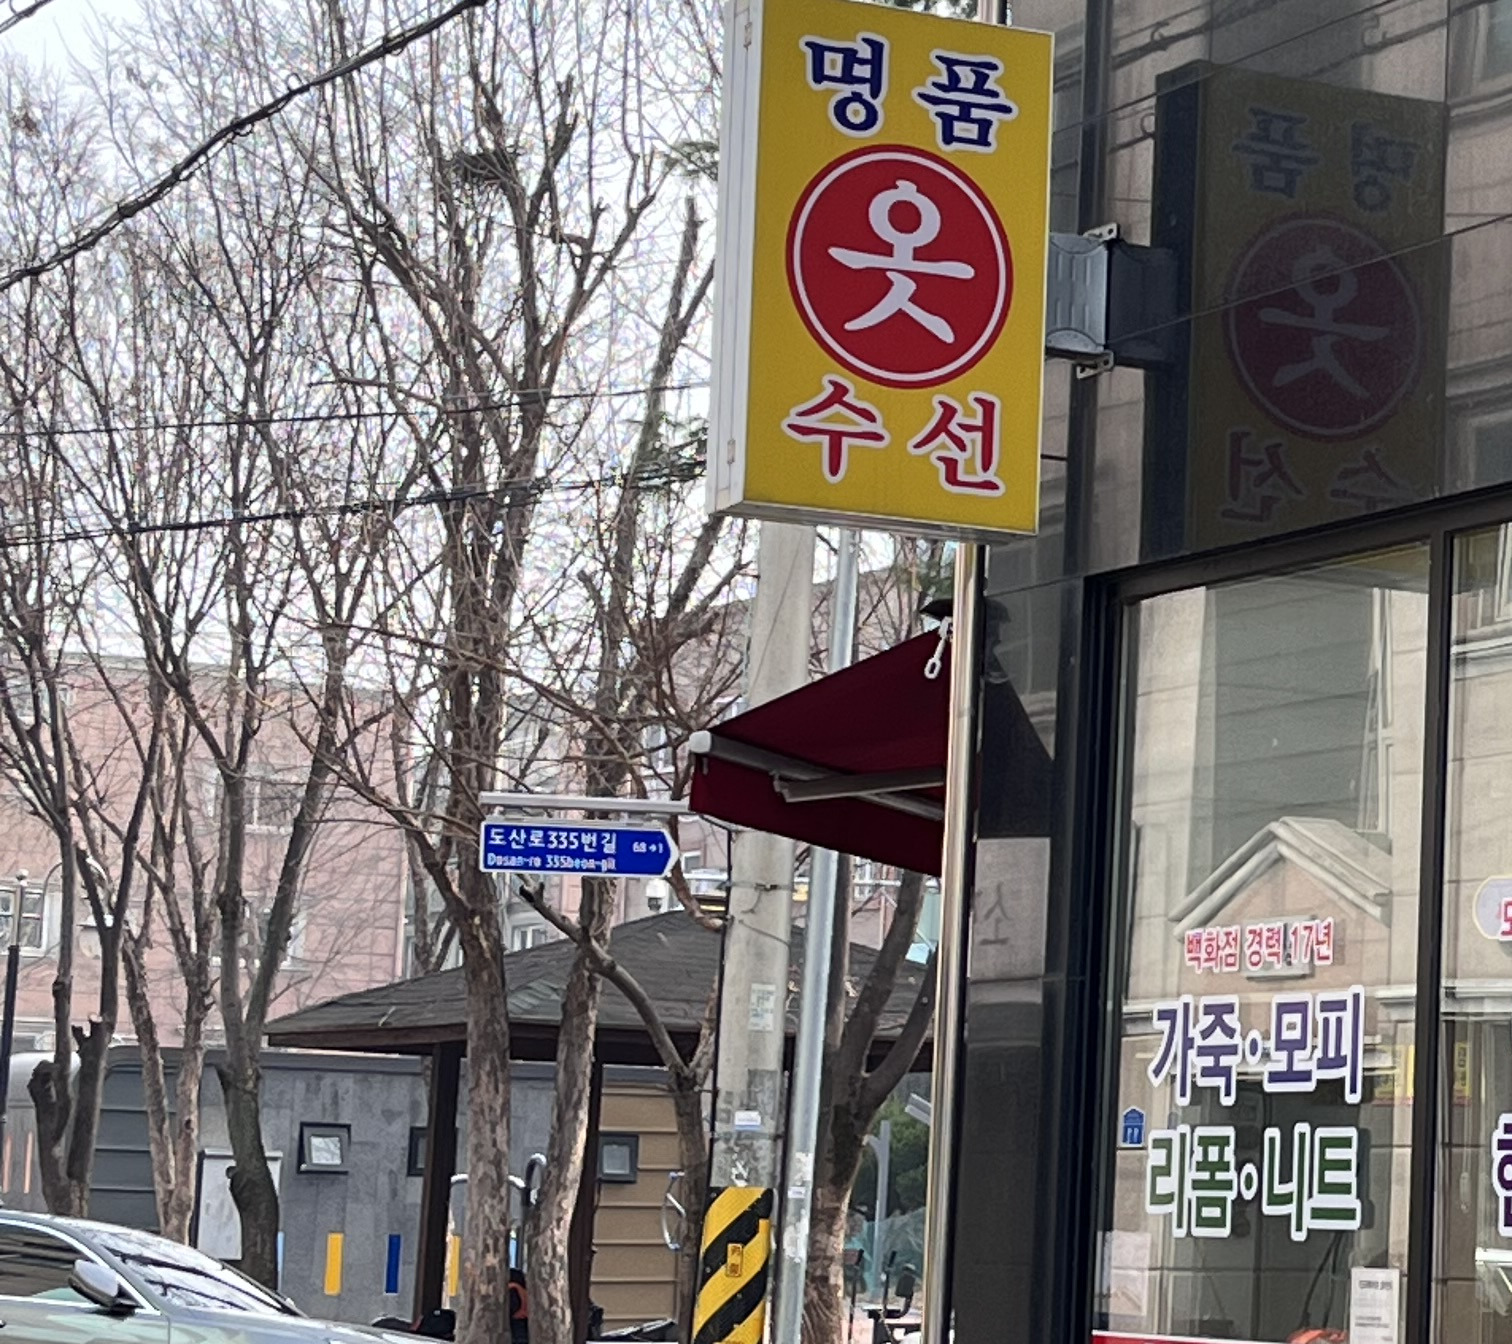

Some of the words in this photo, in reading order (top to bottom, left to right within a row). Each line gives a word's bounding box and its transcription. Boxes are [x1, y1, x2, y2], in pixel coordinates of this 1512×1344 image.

[802, 33, 1015, 148] 명품
[828, 179, 976, 344] 옷
[785, 378, 1002, 492] 수선
[488, 828, 617, 854] 도산로335번길
[1186, 926, 1240, 972] 백화점
[1246, 925, 1282, 970] 경력
[1290, 918, 1333, 965] 17년
